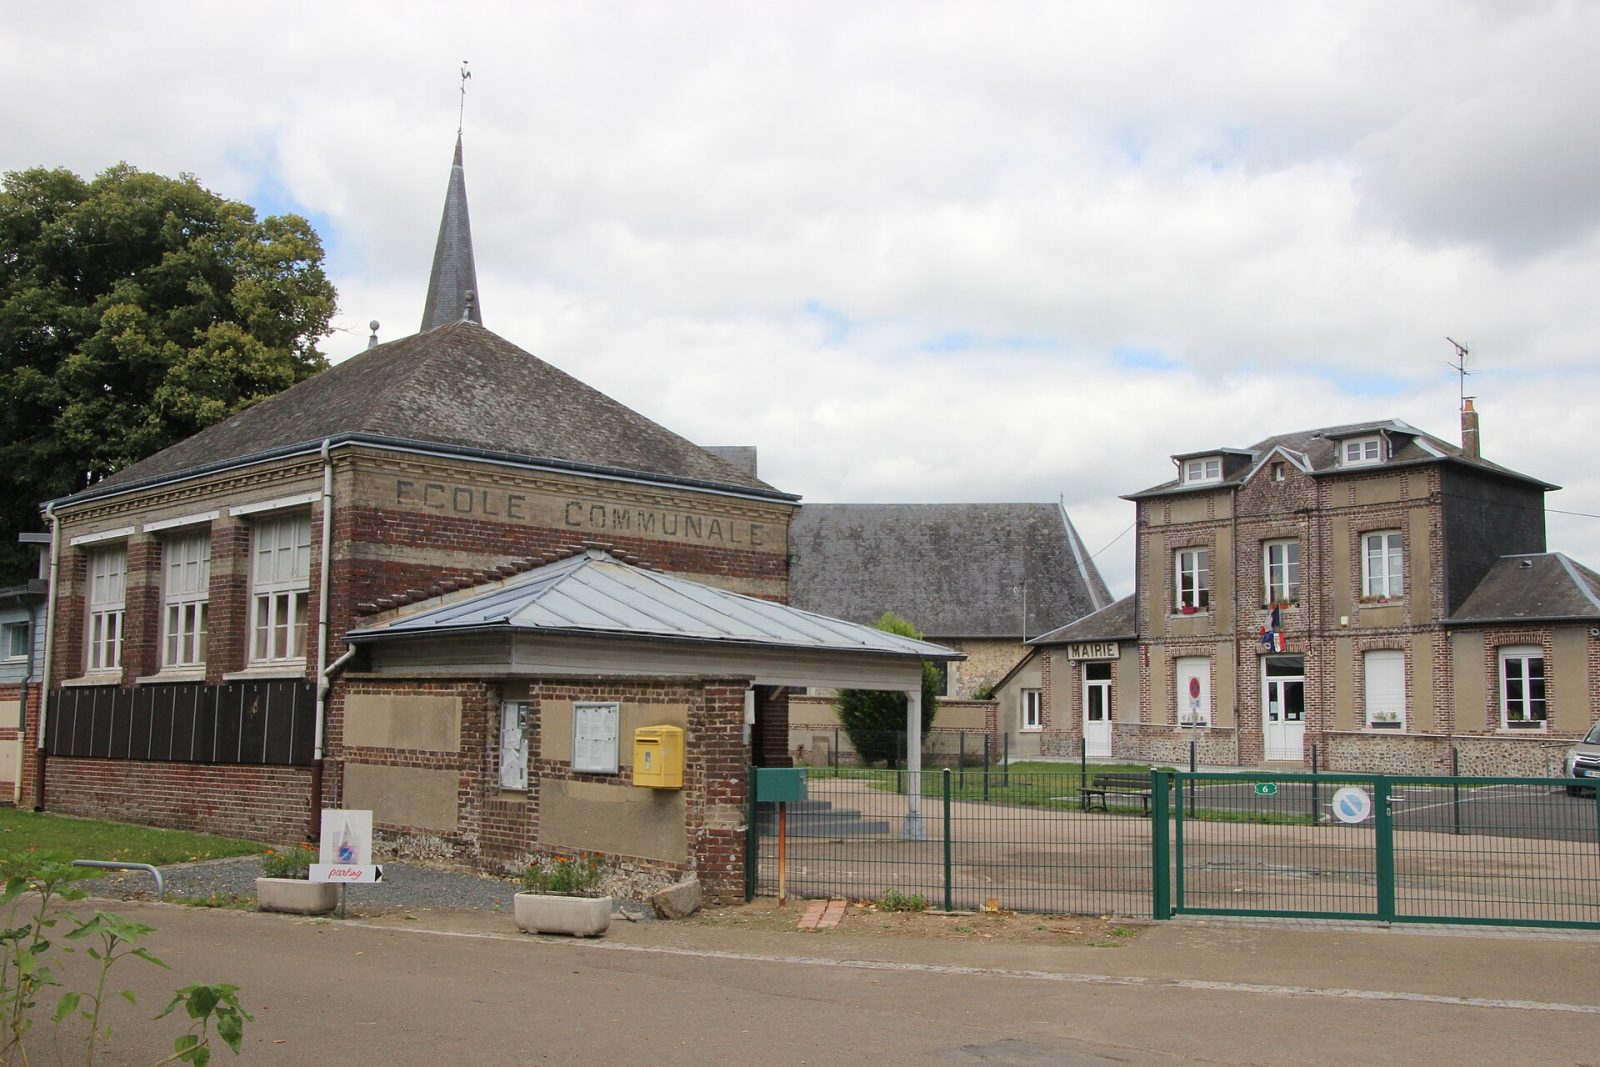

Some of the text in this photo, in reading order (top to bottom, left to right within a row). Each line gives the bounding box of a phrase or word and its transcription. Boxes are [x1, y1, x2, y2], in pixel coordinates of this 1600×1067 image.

[397, 480, 764, 546] ECOLE COMMUNALE
[1071, 643, 1115, 658] MAIRIE
[1262, 785, 1268, 793] 6
